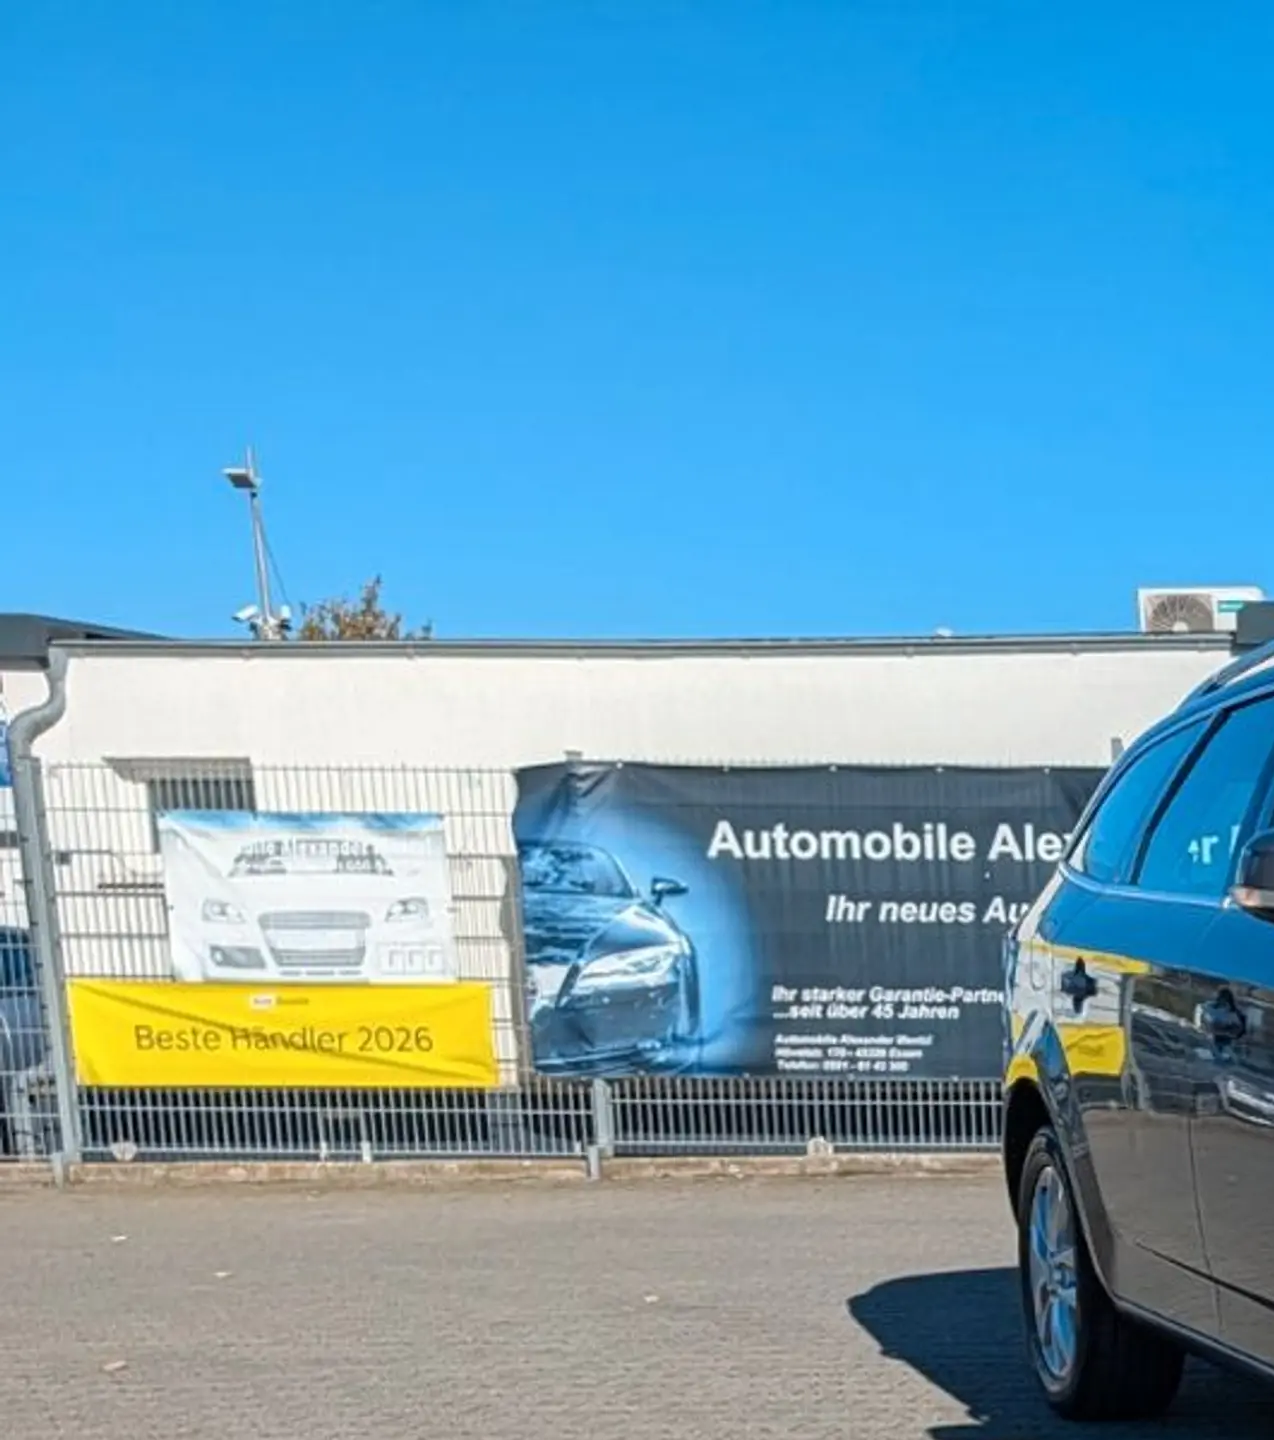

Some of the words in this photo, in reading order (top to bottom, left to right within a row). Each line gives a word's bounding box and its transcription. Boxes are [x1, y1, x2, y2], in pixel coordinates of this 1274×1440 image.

[707, 820, 975, 861] Automobile
[986, 822, 1075, 862] Ale
[826, 894, 872, 922] Ihr
[879, 899, 976, 923] neues
[772, 984, 798, 1002] Ihr
[801, 985, 867, 1003] starker
[826, 1003, 869, 1019] über
[871, 1003, 894, 1019] 45
[897, 1003, 960, 1019] Jahren
[134, 1025, 221, 1051] Beste
[230, 1024, 348, 1052] Händler
[357, 1025, 434, 1052] 2026
